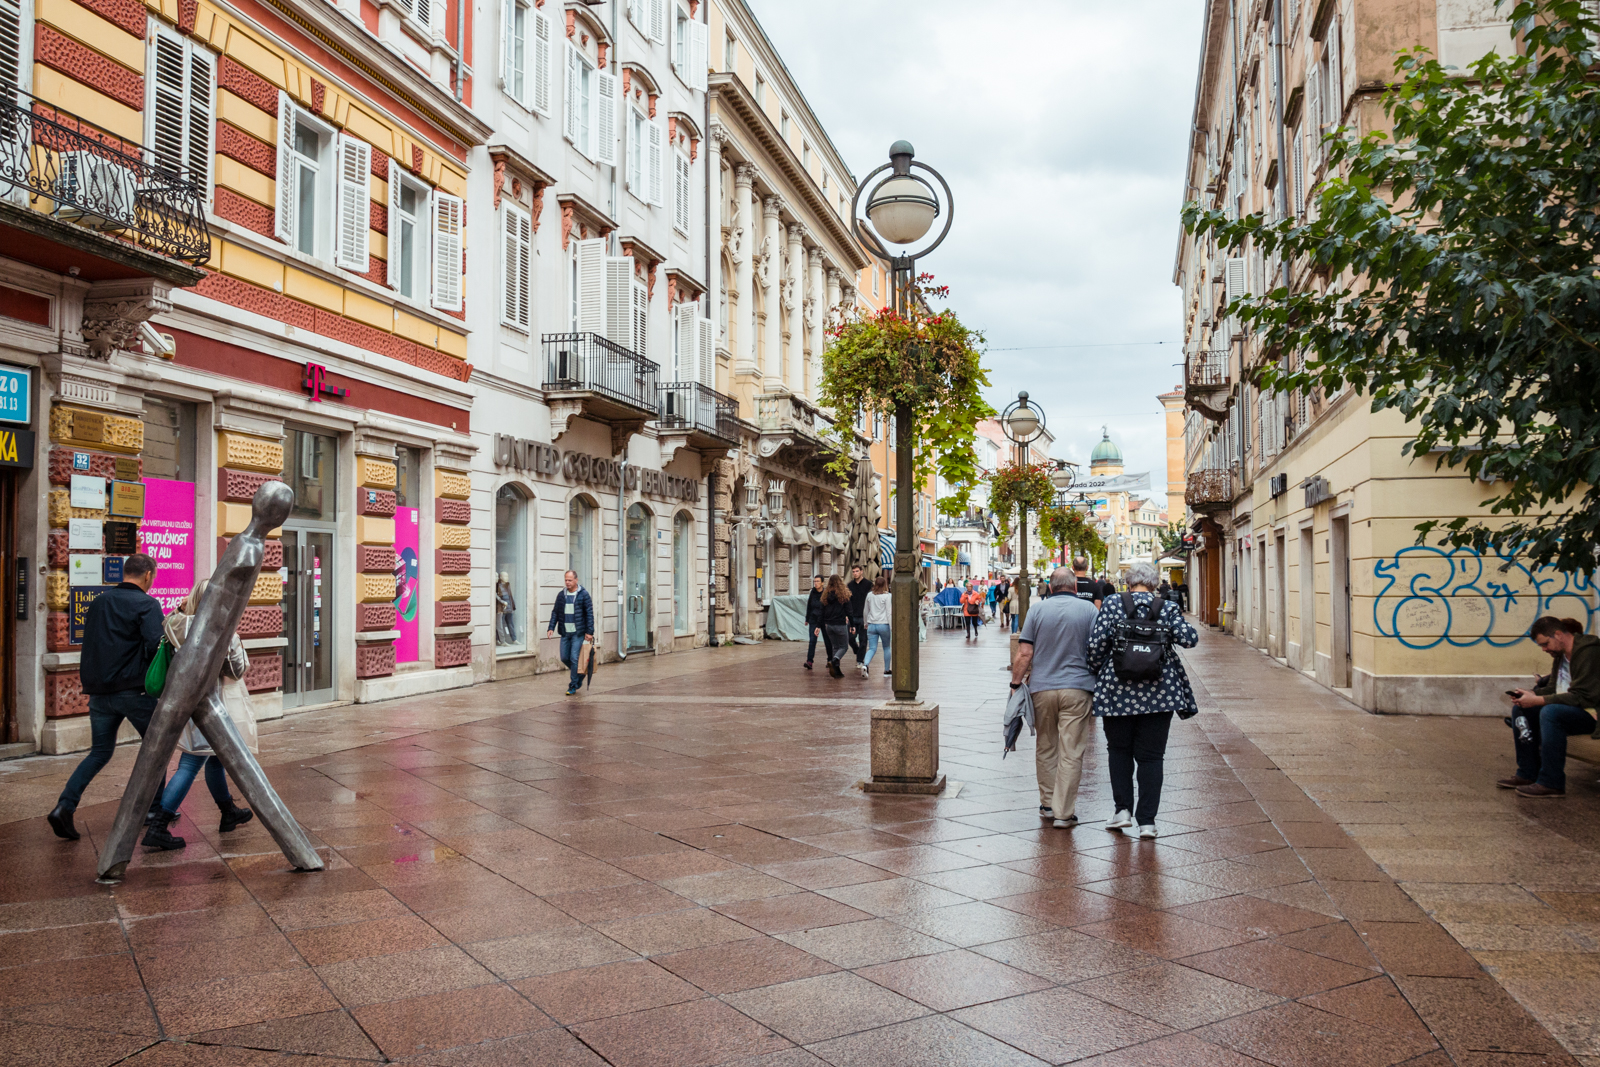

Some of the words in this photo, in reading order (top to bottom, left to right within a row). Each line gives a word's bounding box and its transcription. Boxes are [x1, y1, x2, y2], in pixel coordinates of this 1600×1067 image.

[76, 455, 88, 465] 32
[493, 432, 561, 475] UNITED
[563, 450, 622, 487] COLORS
[622, 464, 642, 491] OF
[641, 467, 700, 502] BENETTON
[145, 529, 188, 546] BUDUĆNOST
[147, 546, 158, 558] BY
[1133, 645, 1151, 653] FILA
